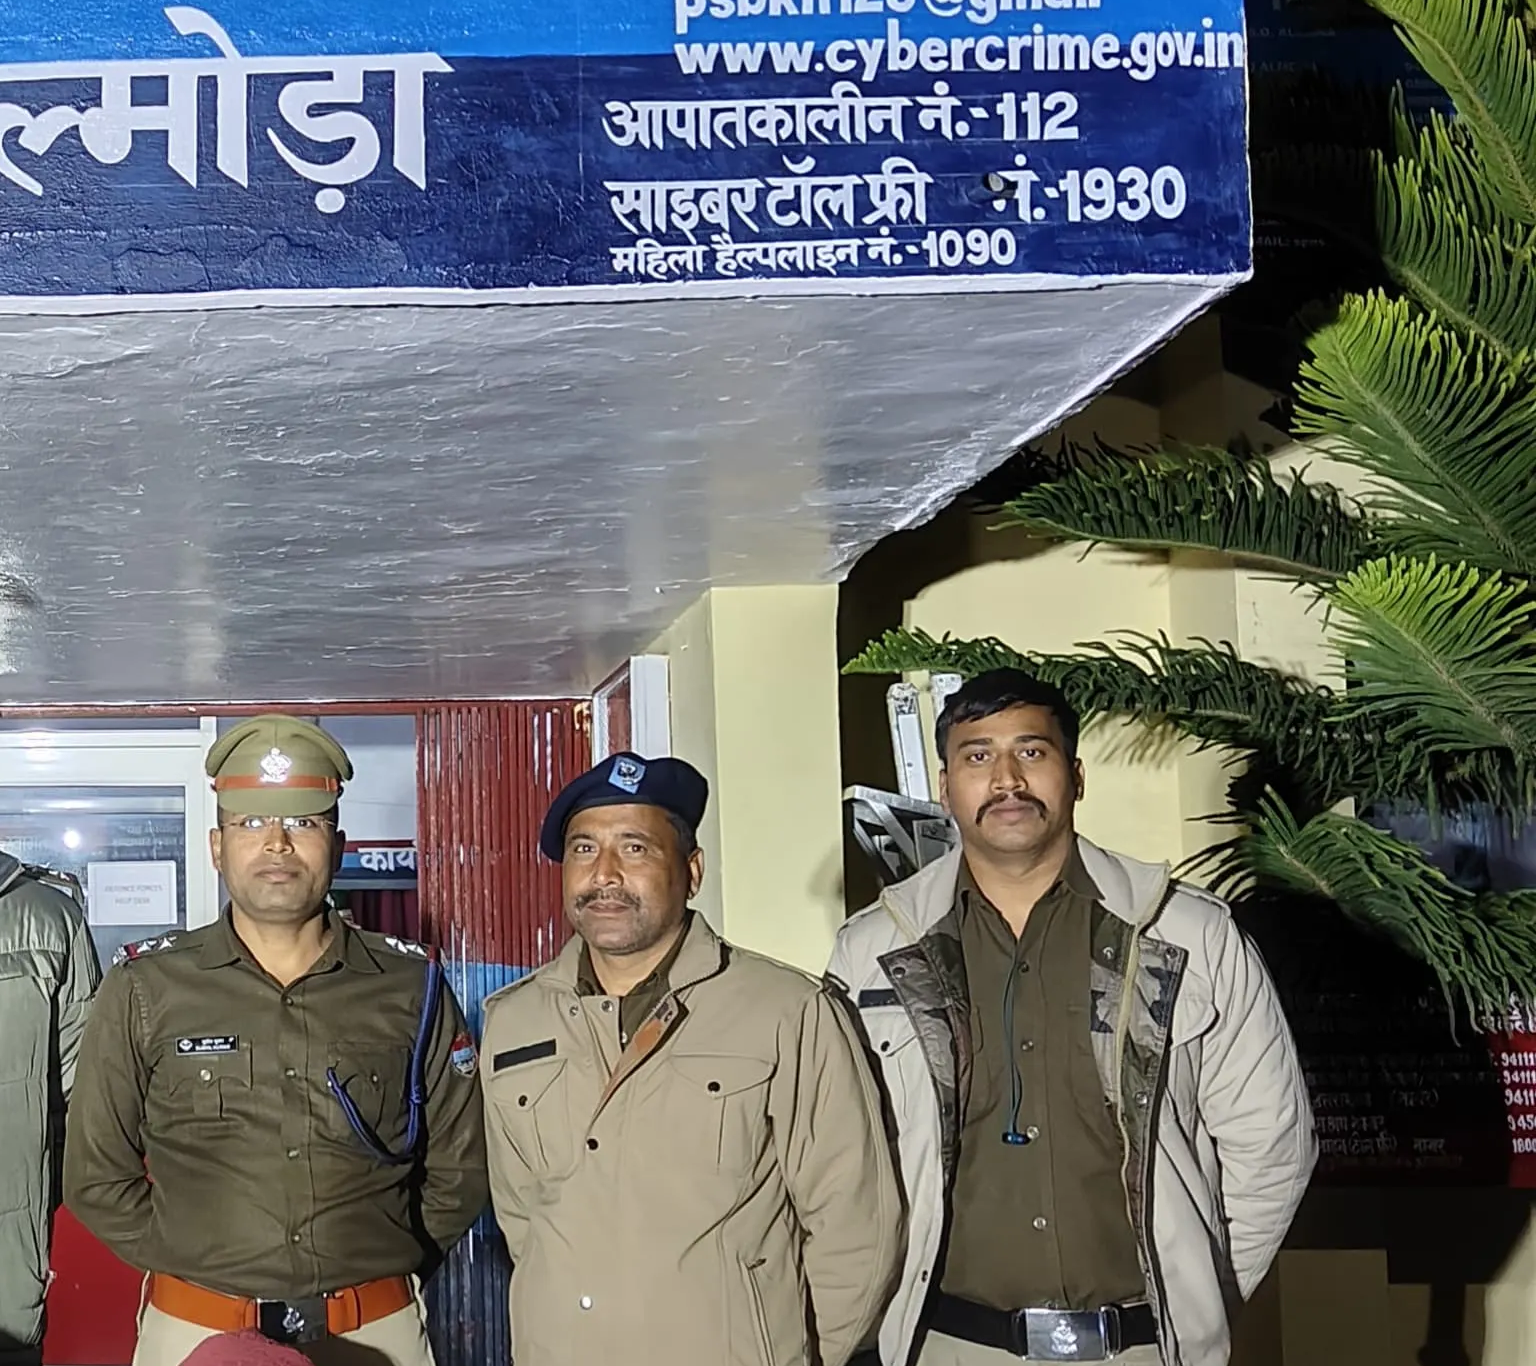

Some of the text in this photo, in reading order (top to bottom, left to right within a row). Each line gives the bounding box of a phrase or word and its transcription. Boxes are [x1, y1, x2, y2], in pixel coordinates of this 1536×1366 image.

[674, 18, 1245, 82] www.cybercrime.gov.in
[602, 80, 913, 151] आपातकालीन
[604, 177, 765, 245] साइबर
[764, 155, 865, 230] टॉल
[861, 157, 934, 230] फ्री
[609, 238, 710, 280] महिला
[710, 232, 863, 276] हैल्पलाइन
